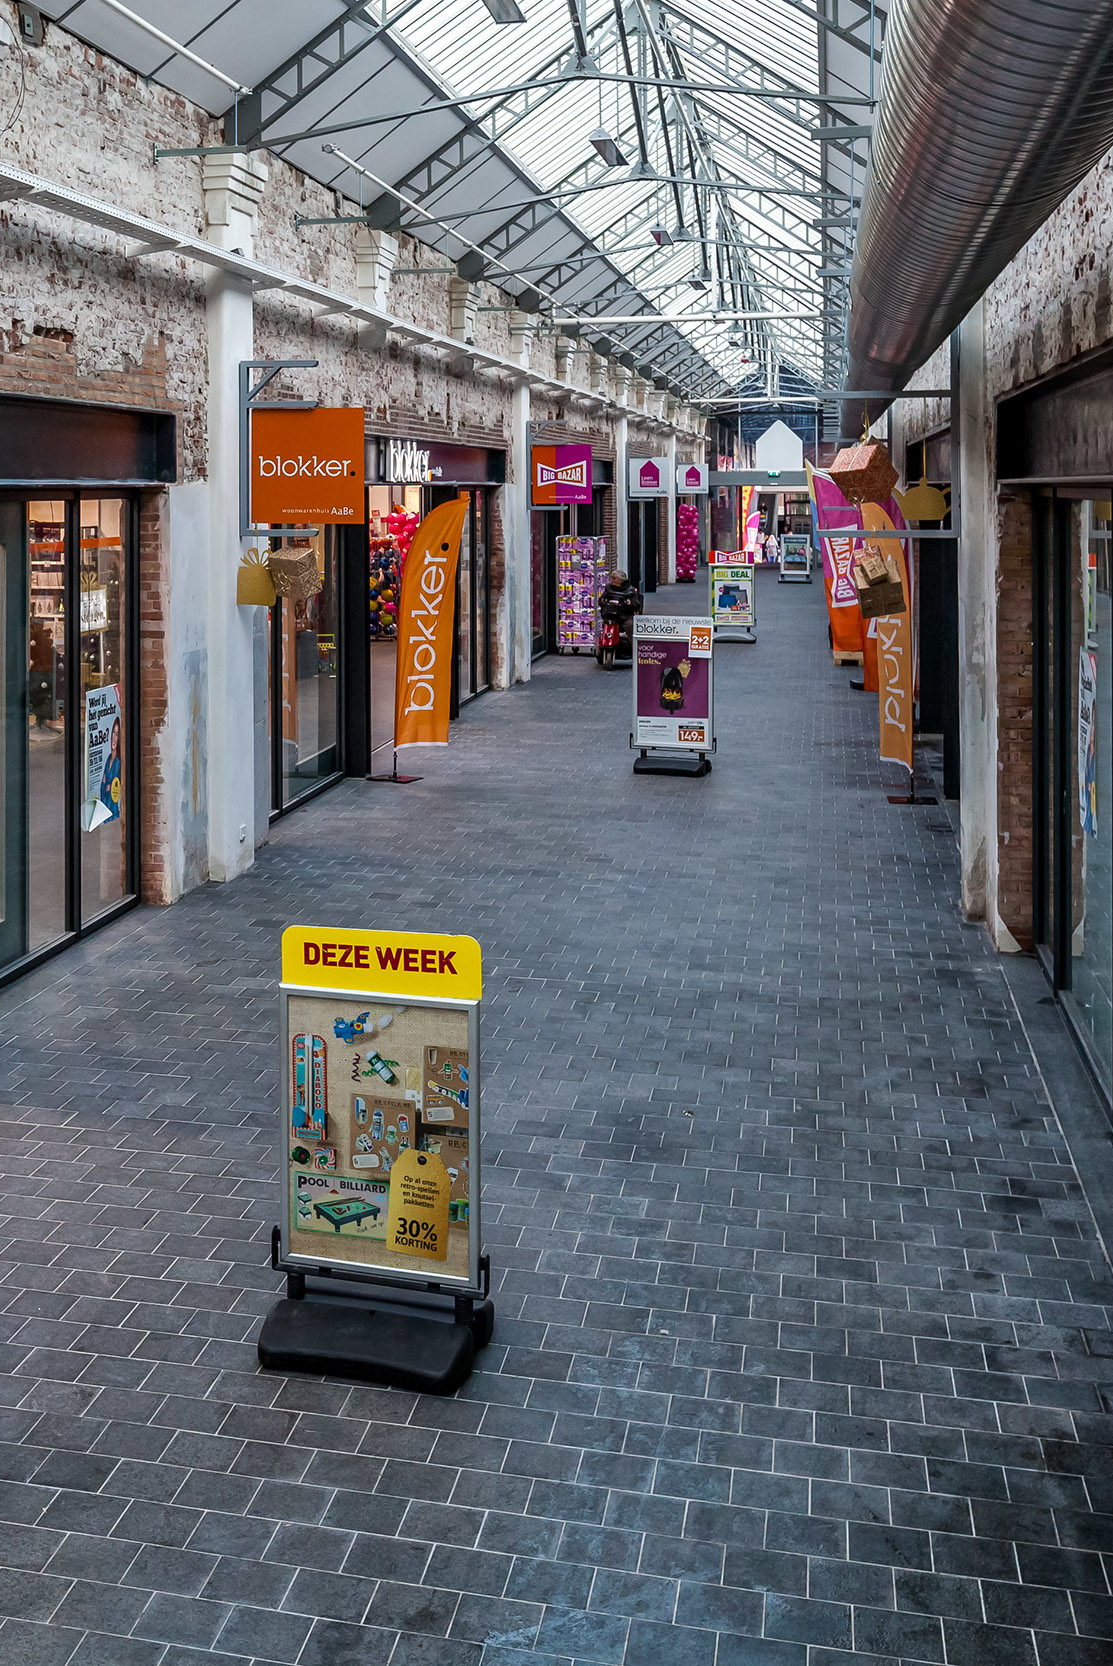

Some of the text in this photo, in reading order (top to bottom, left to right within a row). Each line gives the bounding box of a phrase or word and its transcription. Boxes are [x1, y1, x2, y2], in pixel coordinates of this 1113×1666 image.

[542, 467, 581, 482] BIG BAZAR
[330, 506, 355, 516] AaBe
[716, 570, 750, 578] BIG DEAL
[638, 651, 667, 659] handige
[89, 703, 116, 721] het gezicht
[89, 722, 98, 732] van
[89, 727, 110, 748] AaBe?
[303, 942, 458, 975] DEZE WEEK
[313, 1062, 322, 1109] DIABOLO
[298, 1175, 386, 1194] POOL BILLIARD
[400, 1182, 440, 1195] retro-spellen
[403, 1175, 437, 1187] Op al onze
[403, 1198, 435, 1209] pakketten
[396, 1217, 438, 1242] 30%
[395, 1235, 438, 1252] KORTING
